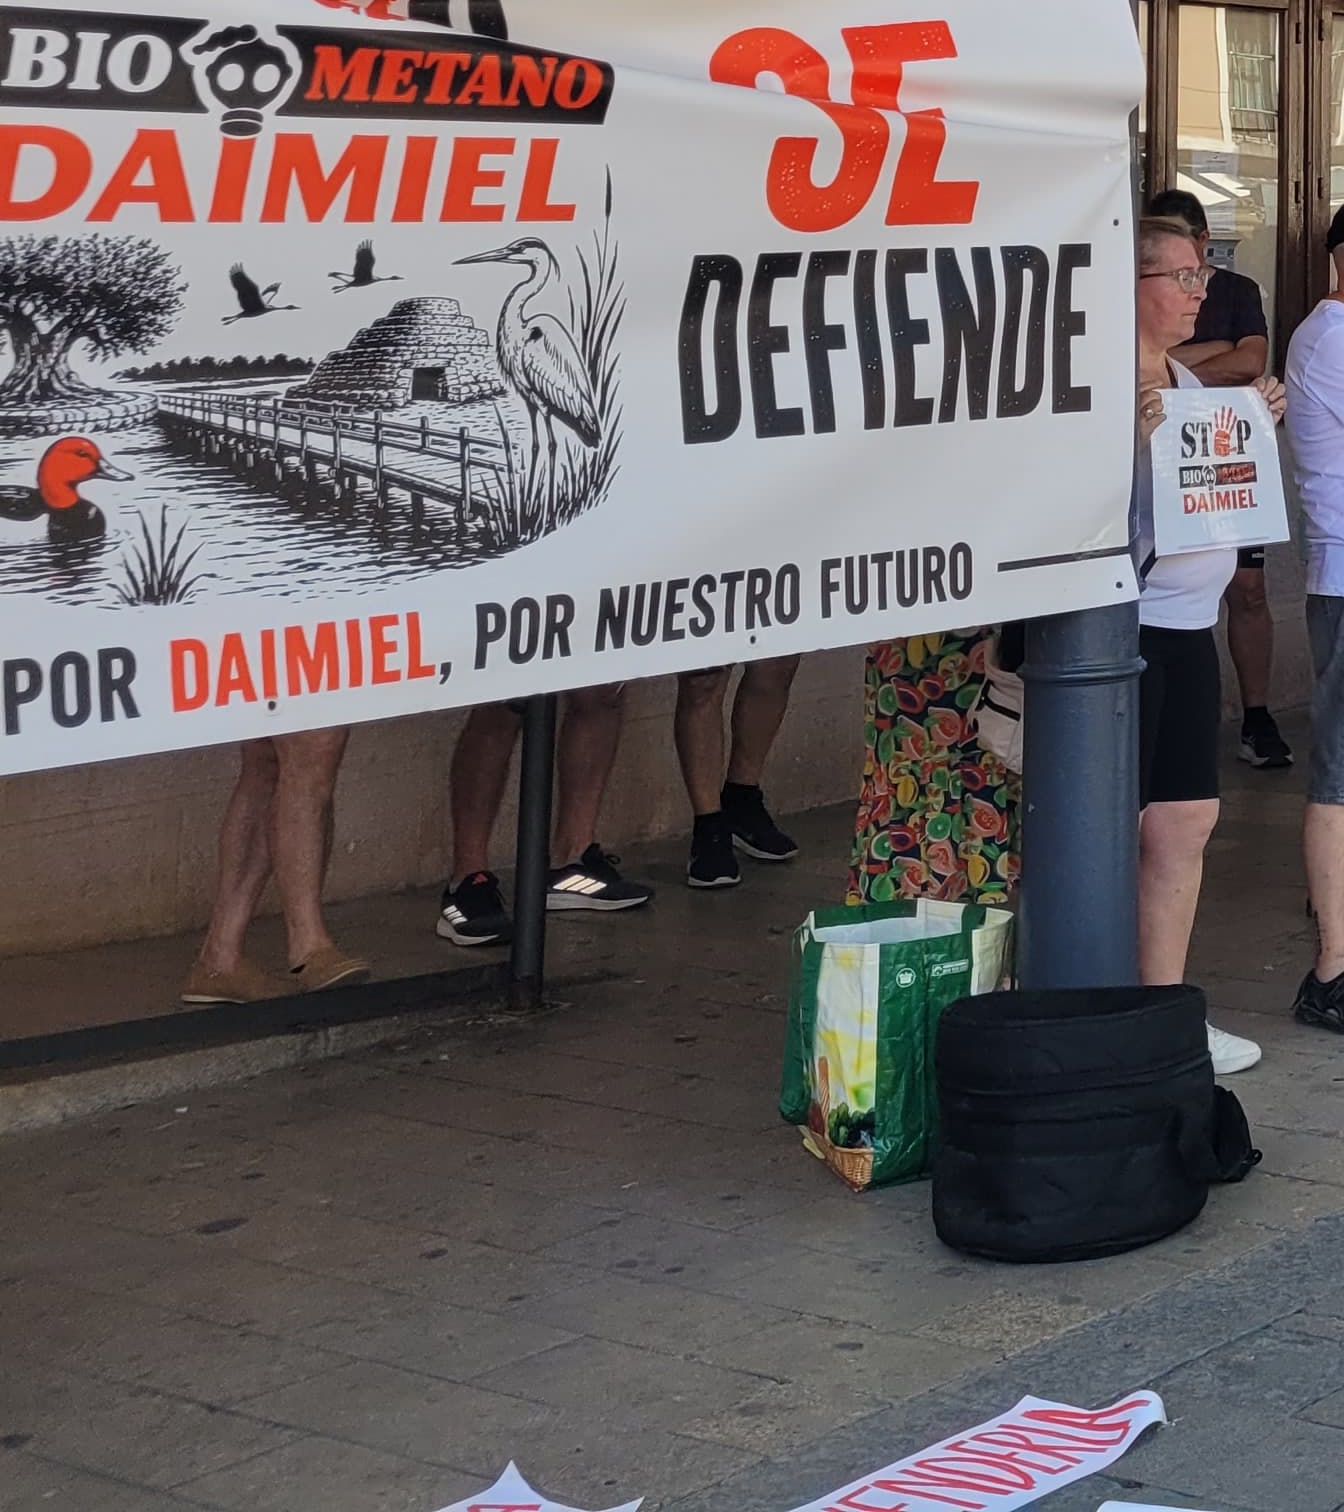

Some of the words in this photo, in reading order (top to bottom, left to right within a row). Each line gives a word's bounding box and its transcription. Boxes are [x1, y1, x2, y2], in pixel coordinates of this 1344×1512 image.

[2, 28, 173, 91] BIO
[304, 44, 604, 109] METANO
[0, 123, 577, 224] DAIMIEL
[708, 19, 980, 233] SE
[678, 243, 1092, 445] DEFIENDE
[1182, 469, 1202, 485] BIO
[1183, 488, 1258, 515] DAIMIEL
[3, 646, 140, 737] POR
[169, 612, 453, 714] DAIMIEL,
[474, 594, 577, 671] POR
[599, 562, 802, 652] NUESTRO
[819, 541, 974, 621] FUTURO
